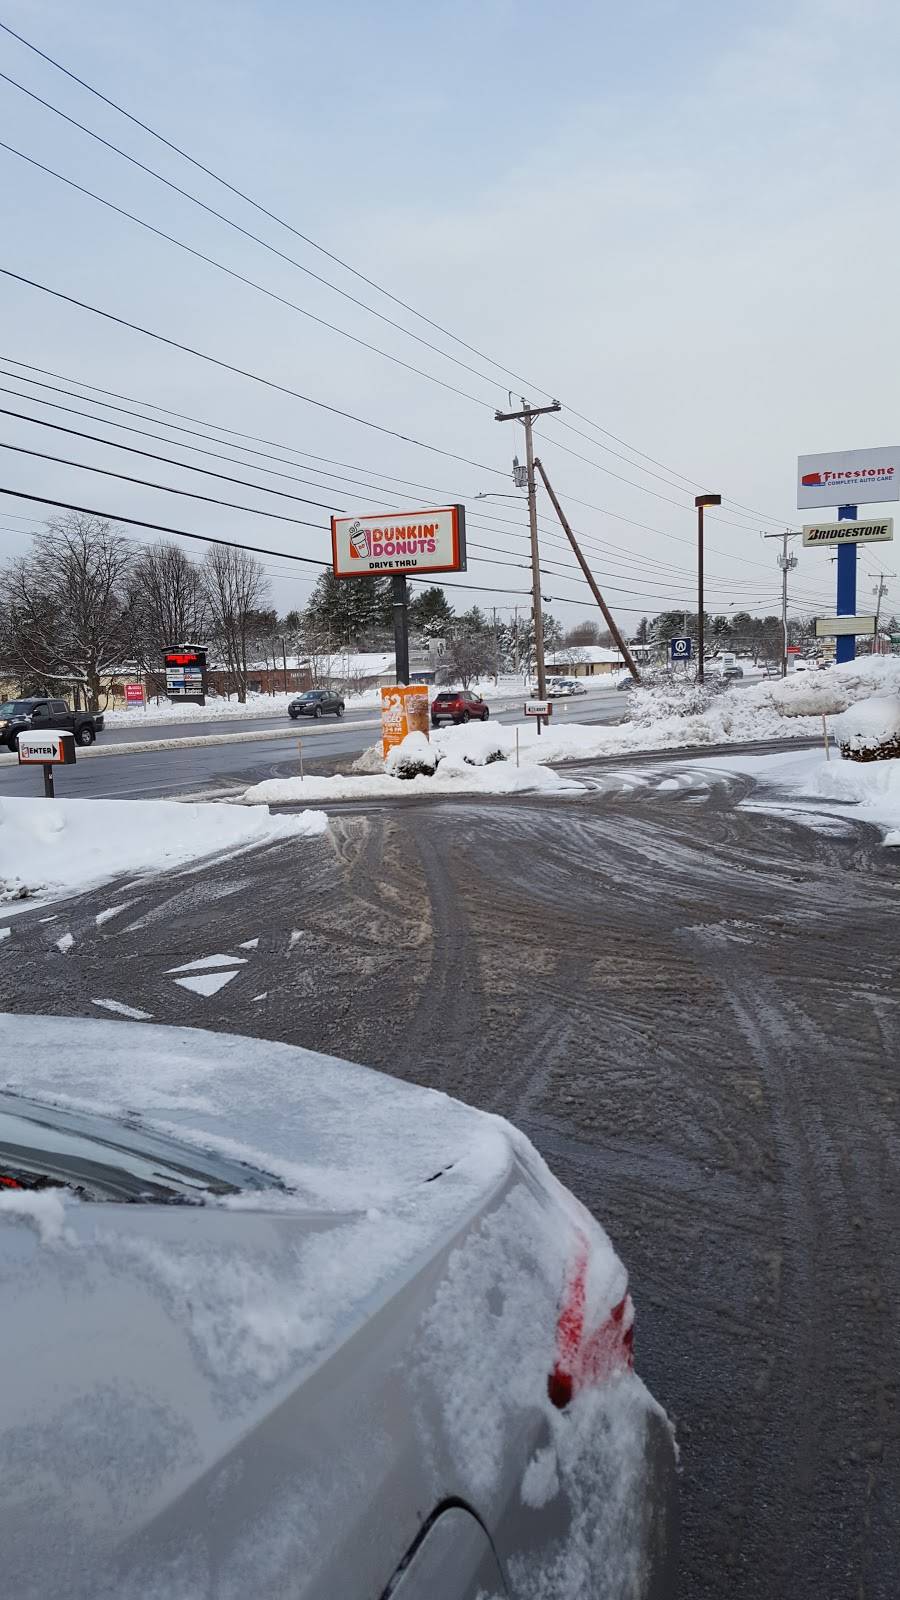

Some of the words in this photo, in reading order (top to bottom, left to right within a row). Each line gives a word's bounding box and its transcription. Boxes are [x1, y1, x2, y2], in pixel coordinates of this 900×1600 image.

[823, 467, 895, 482] Firestone
[828, 473, 858, 485] COMPLETE
[859, 472, 876, 483] AUTO
[877, 471, 893, 481] CARE
[372, 524, 439, 542] DUNKIN'
[807, 525, 888, 540] BRIDGESTONE
[373, 538, 436, 556] DONUTS
[369, 560, 393, 569] DRIVE
[396, 559, 417, 567] THRU
